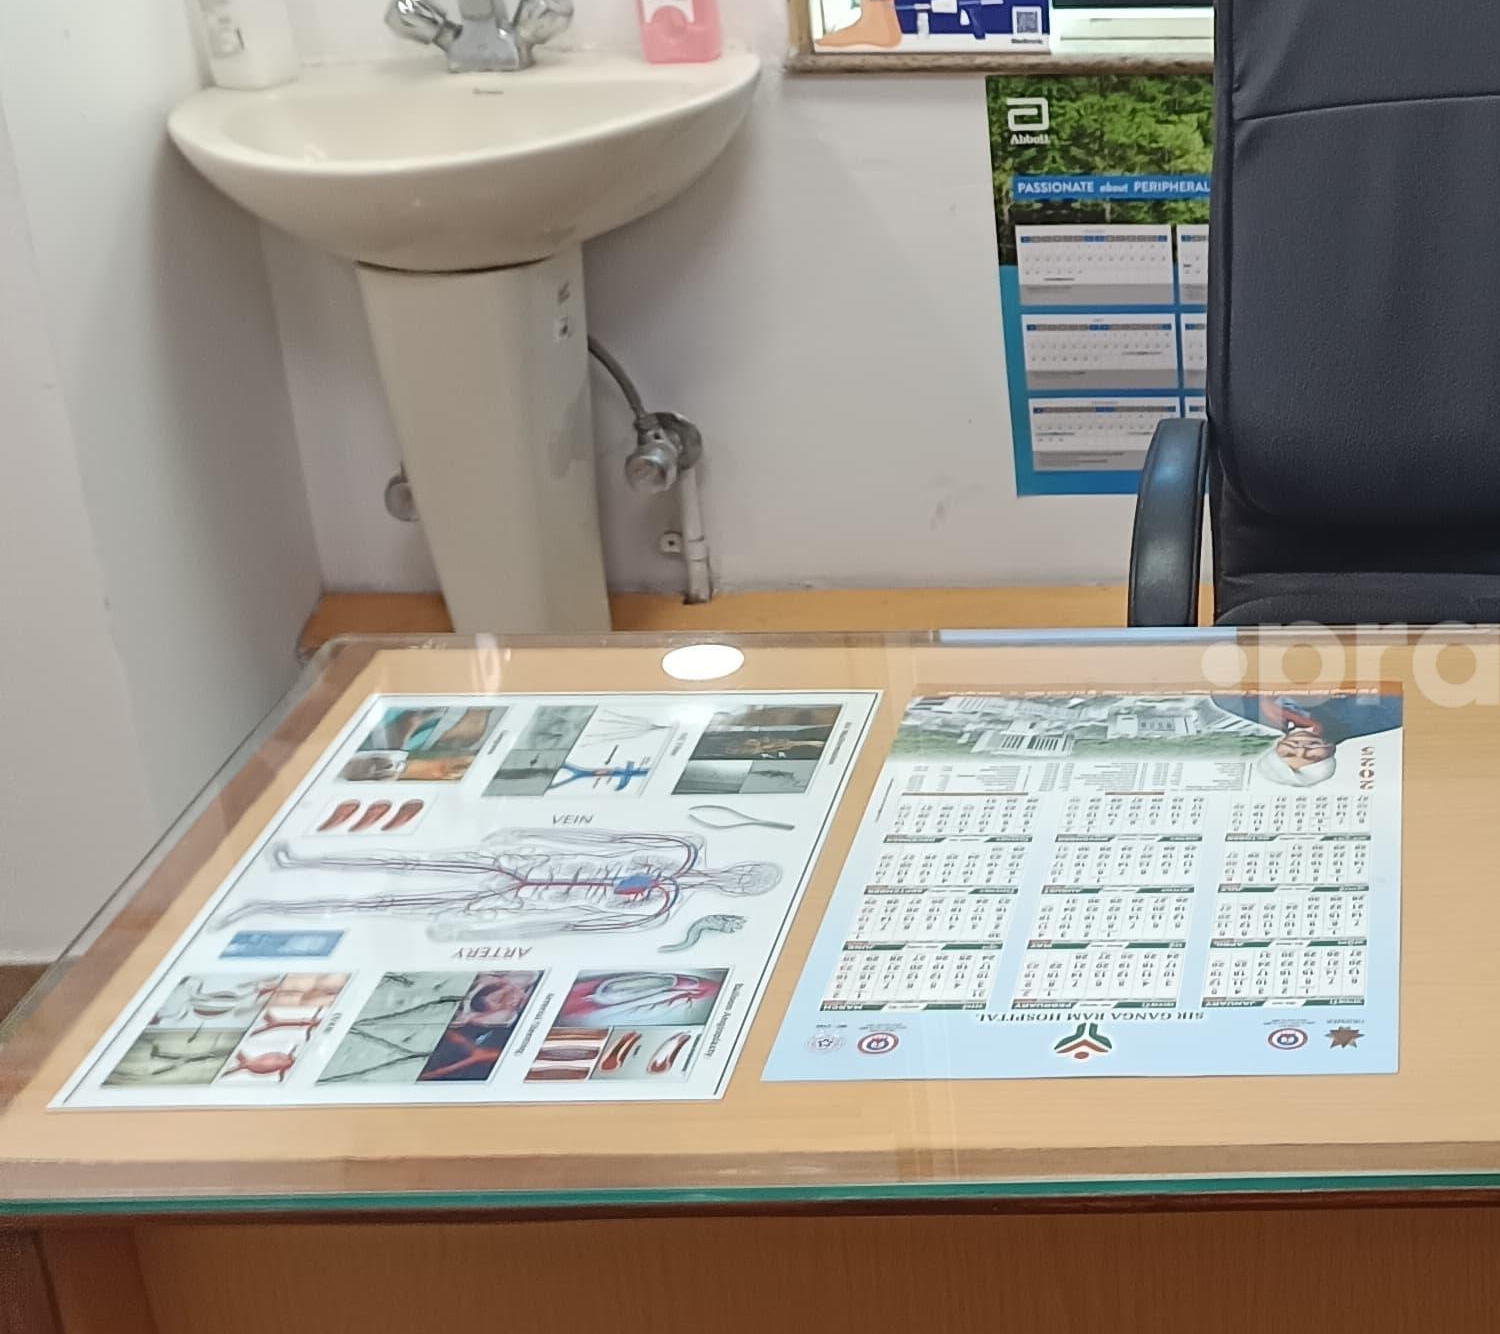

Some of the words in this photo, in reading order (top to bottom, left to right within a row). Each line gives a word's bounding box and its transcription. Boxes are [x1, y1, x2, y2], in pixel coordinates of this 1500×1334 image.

[1017, 180, 1094, 194] PASSIONATE
[1100, 181, 1129, 193] about
[1134, 180, 1210, 193] PERIPHERAL
[552, 814, 594, 825] VEIN
[450, 946, 533, 961] ARTERY
[980, 1012, 1061, 1022] HOSPITAL
[1066, 1012, 1105, 1021] RAM
[1110, 1012, 1172, 1021] GANGA
[1177, 1012, 1204, 1021] SIR
